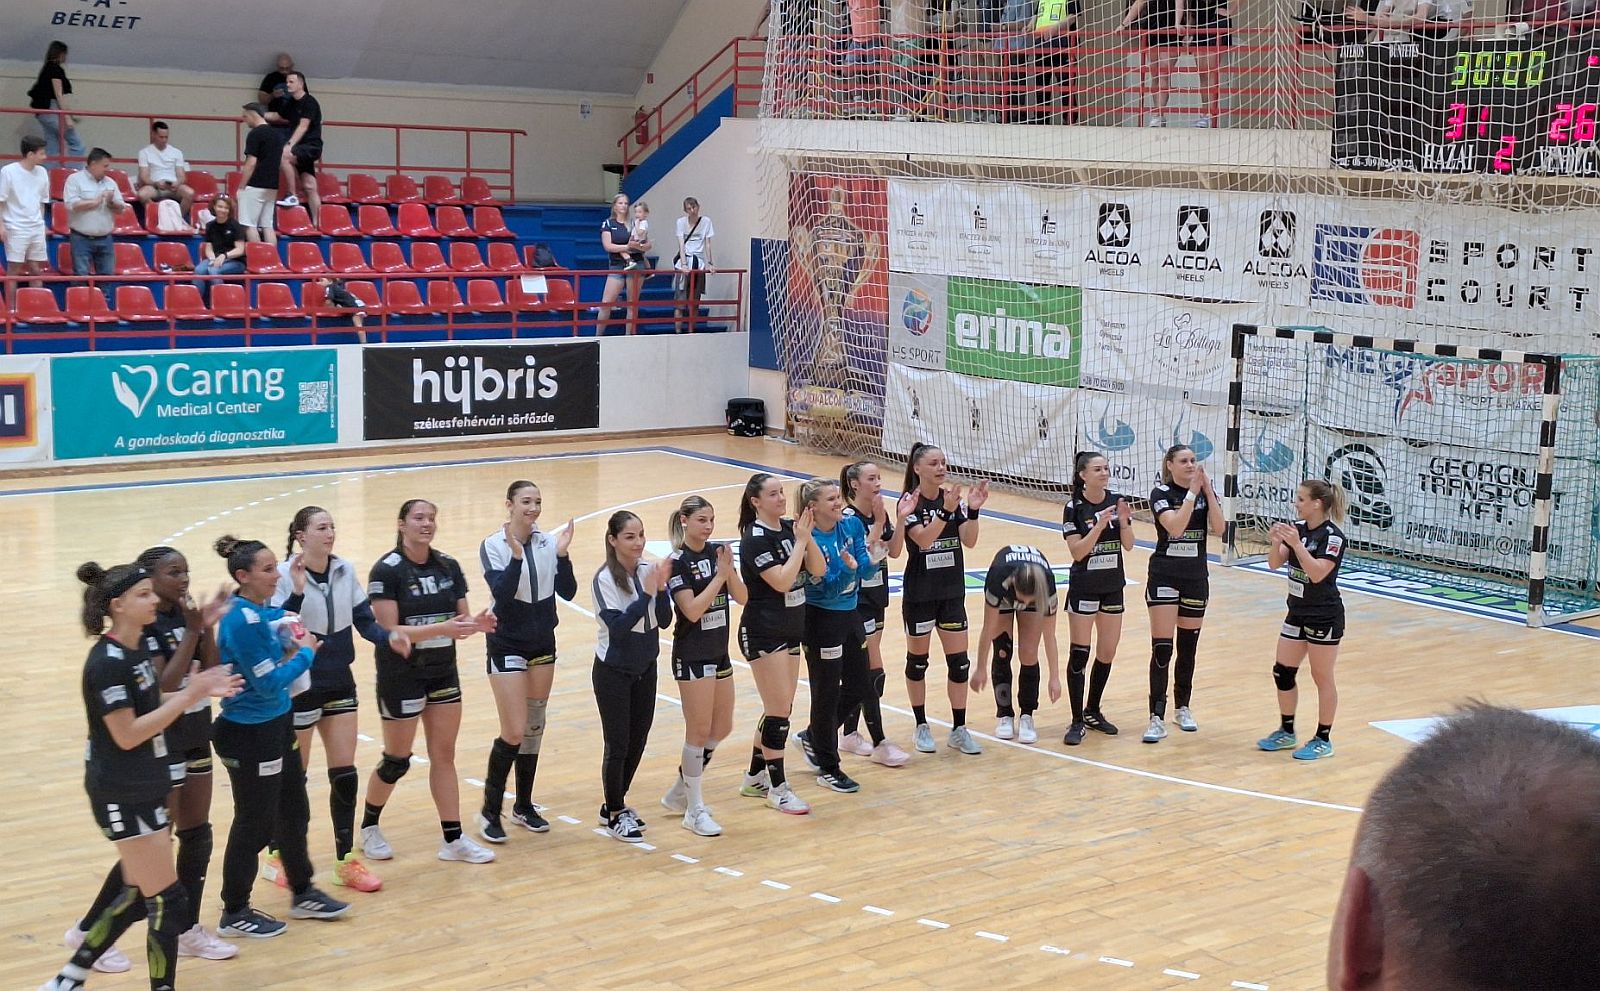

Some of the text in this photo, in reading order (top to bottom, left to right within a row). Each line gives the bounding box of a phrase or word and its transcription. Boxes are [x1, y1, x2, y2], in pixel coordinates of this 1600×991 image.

[51, 10, 141, 30] BÉRLET
[1451, 51, 1546, 85] 30:00
[1445, 103, 1489, 139] 31
[1549, 103, 1596, 140] 26
[1423, 144, 1474, 171] HAZAI
[1493, 135, 1517, 171] 2
[1085, 249, 1142, 266] ALCOA
[1161, 254, 1222, 272] ALCOA
[1429, 239, 1593, 272] SPORT
[1099, 268, 1125, 277] WHEELS
[1176, 273, 1205, 283] WHEELS
[1242, 260, 1308, 279] ALCOA
[1427, 278, 1590, 312] COURT
[955, 308, 1071, 360] erima
[909, 347, 941, 364] SPORT
[166, 361, 285, 401] Caring
[157, 402, 262, 418] Medical Center
[413, 412, 555, 430] székesfehérvári sörfőzde
[115, 427, 285, 450] A gondoskodó diagnosztika
[1430, 457, 1537, 489] GEORGIU
[1237, 481, 1295, 503] GÁRDI
[1418, 473, 1566, 511] TRANSPOT
[1459, 499, 1513, 526] KFT.
